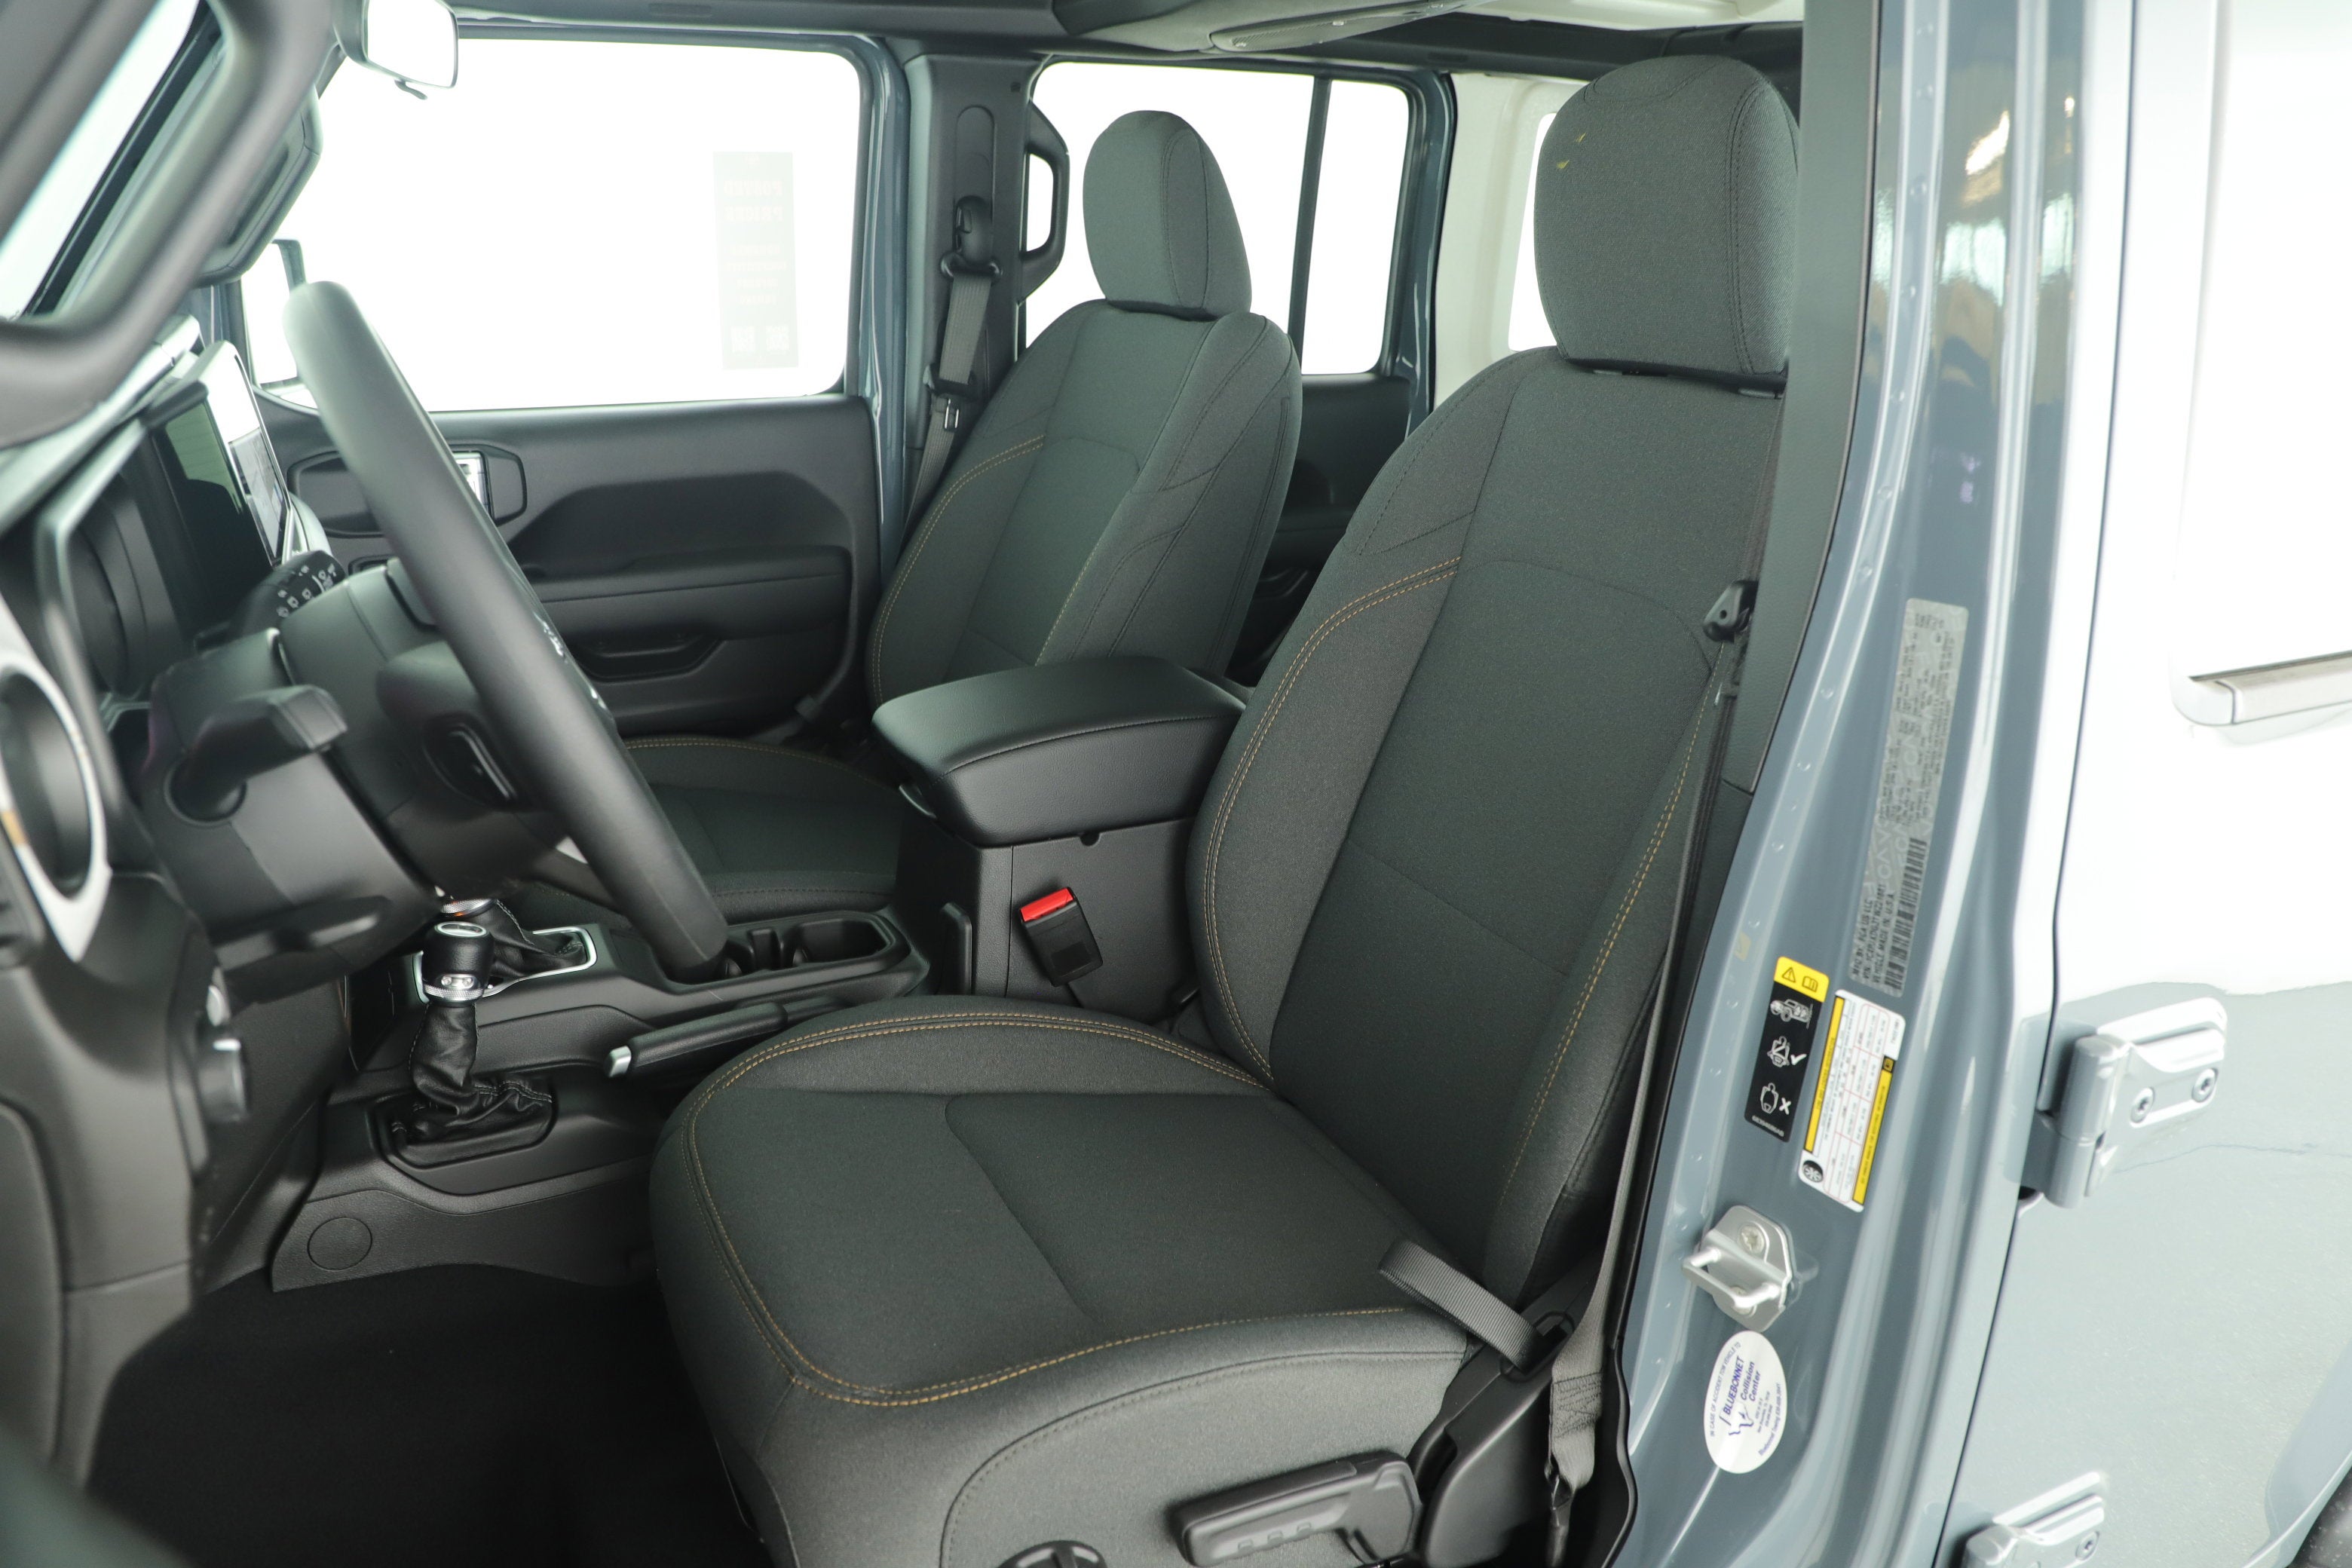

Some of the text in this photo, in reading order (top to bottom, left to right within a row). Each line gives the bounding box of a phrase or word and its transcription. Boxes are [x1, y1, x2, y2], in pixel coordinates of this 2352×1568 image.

[1710, 1404, 1716, 1412] OF
[1713, 1376, 1722, 1403] ACCIDENT
[1723, 1355, 1744, 1415] BLUEBONNET
[1740, 1361, 1755, 1401] Collision
[1749, 1370, 1761, 1401] Center
